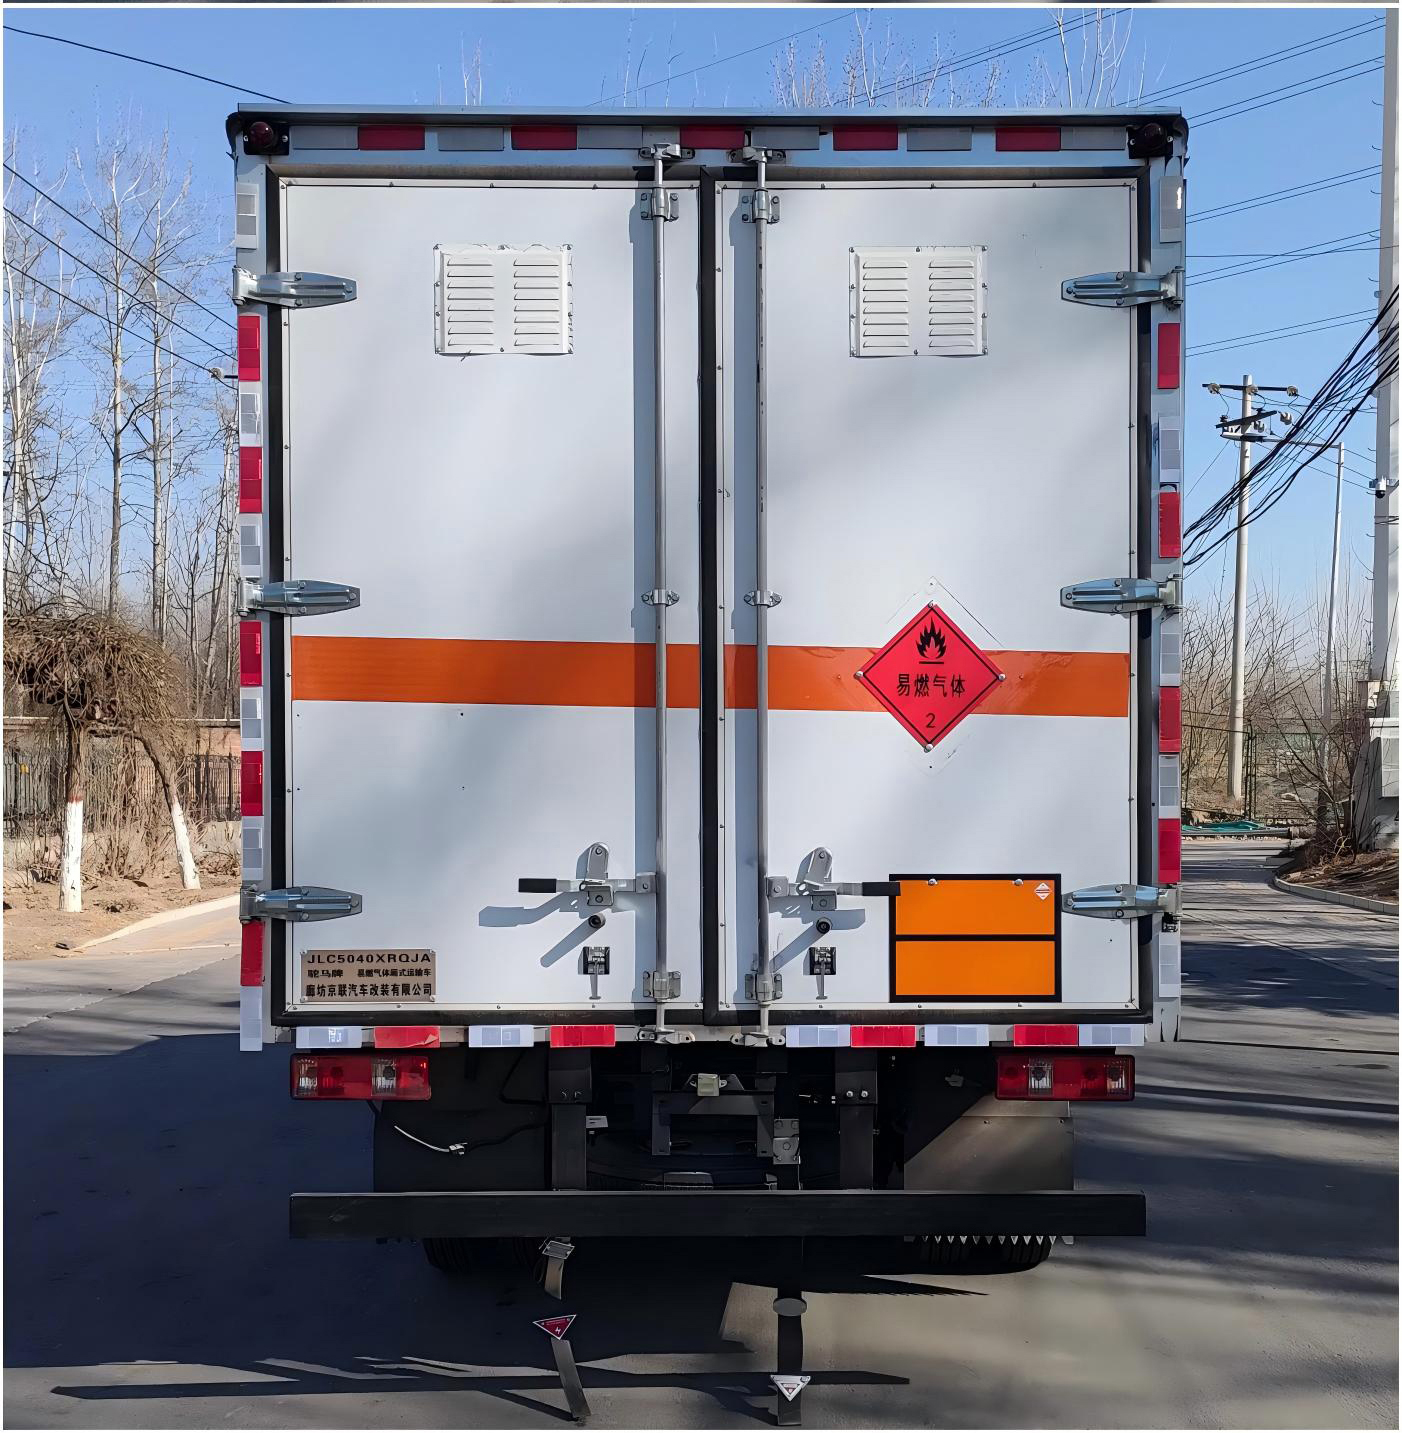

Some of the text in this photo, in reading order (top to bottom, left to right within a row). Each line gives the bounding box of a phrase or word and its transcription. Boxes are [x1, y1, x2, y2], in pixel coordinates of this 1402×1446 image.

[896, 672, 966, 698] 易燃气体
[925, 712, 936, 729] 2
[307, 953, 431, 964] JLC5040XRQJA
[305, 983, 432, 997] 廊坊京联汽车改装有限公司
